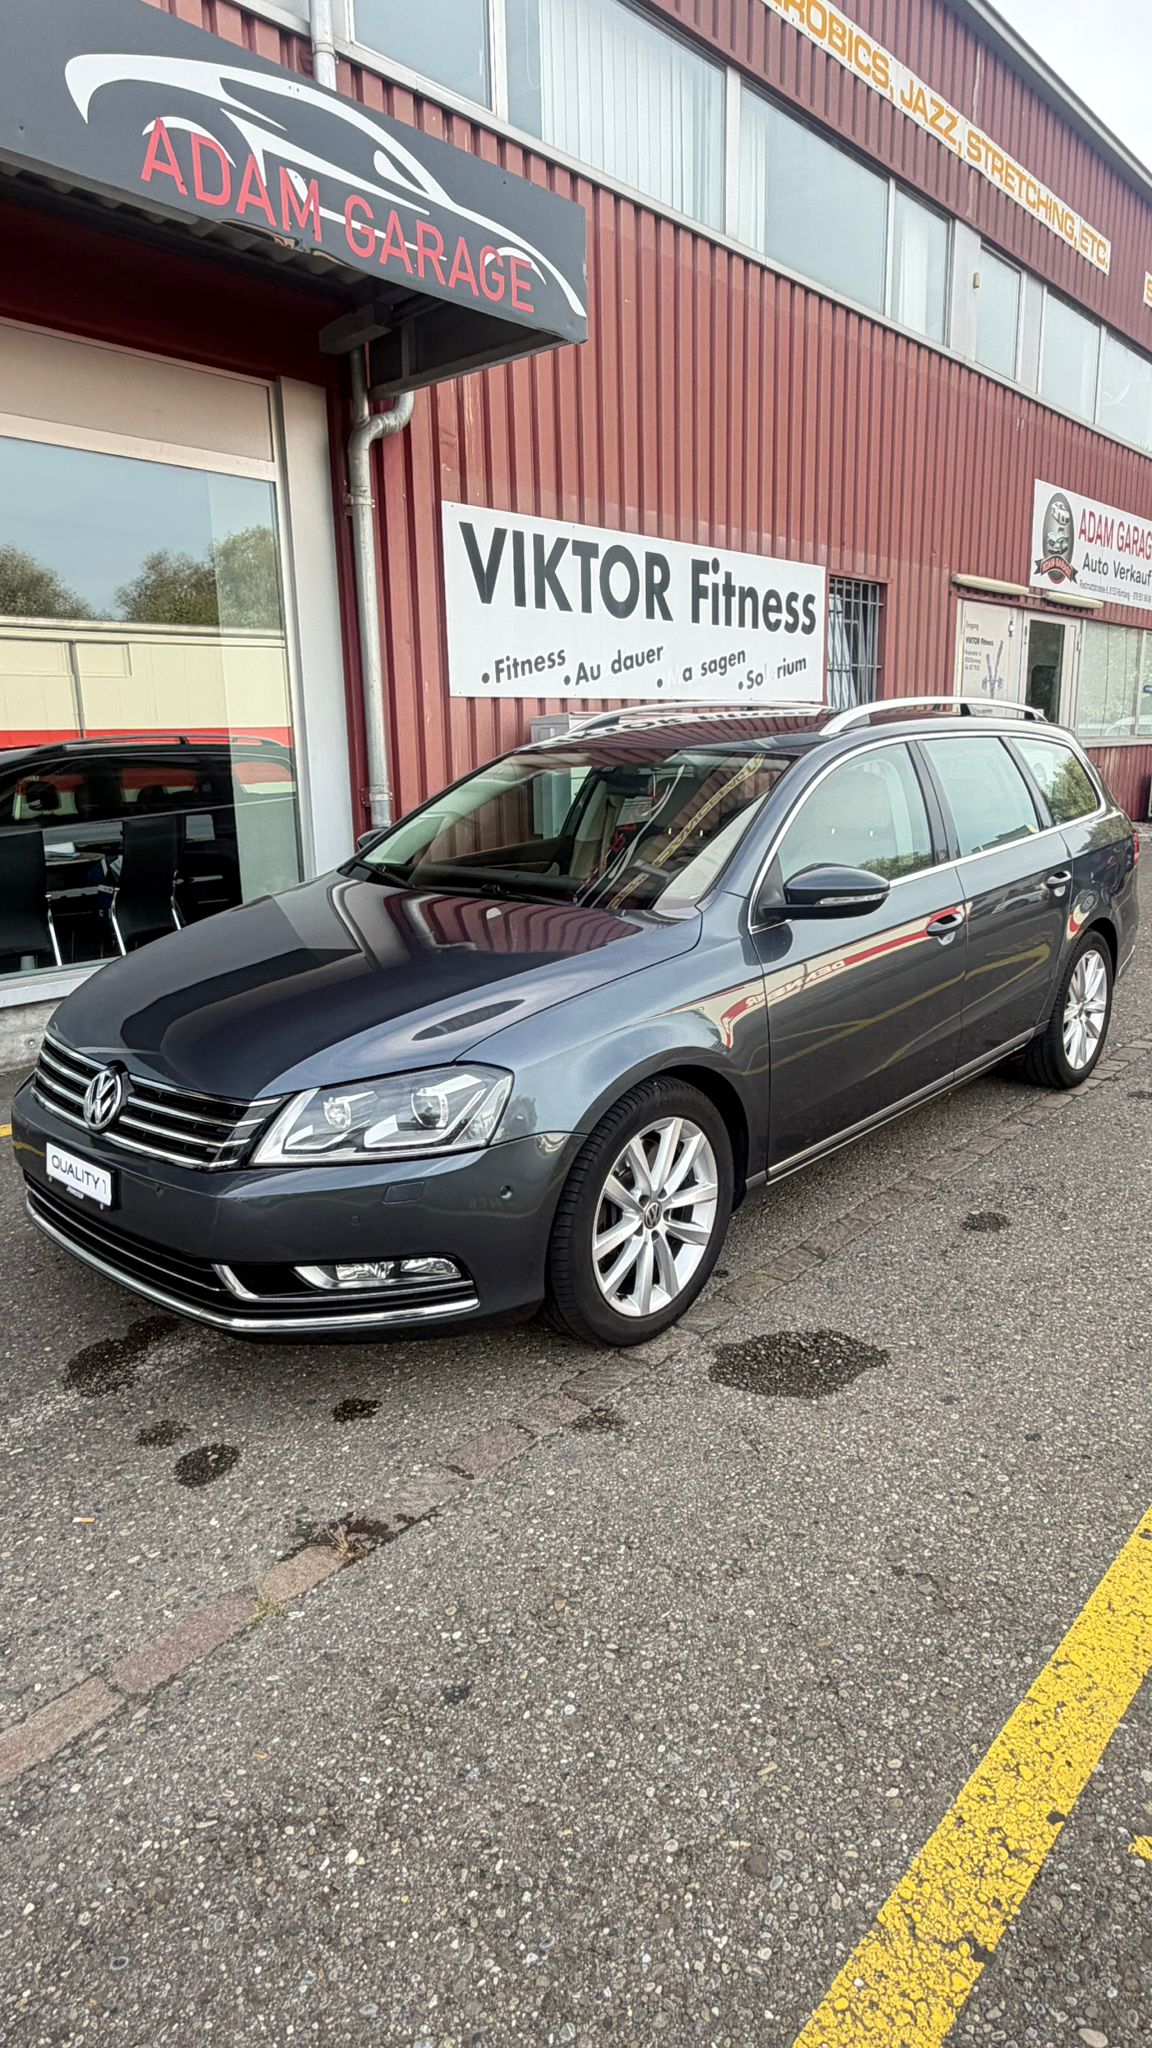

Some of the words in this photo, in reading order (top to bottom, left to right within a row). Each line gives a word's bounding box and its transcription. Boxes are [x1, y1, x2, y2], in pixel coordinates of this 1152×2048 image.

[771, 0, 894, 101] ROBICS,
[899, 79, 963, 157] JAZZ,
[966, 130, 1077, 248] STRETCHING,
[141, 116, 323, 242] ADAM
[344, 195, 535, 313] GARAGE
[1079, 508, 1114, 549] ADAM
[459, 521, 673, 621] VIKTOR
[691, 557, 816, 635] Fitness
[1082, 552, 1109, 576] Auto
[494, 648, 566, 684] Fitness
[575, 644, 664, 686] Audauer
[52, 1155, 100, 1189] QUALITY
